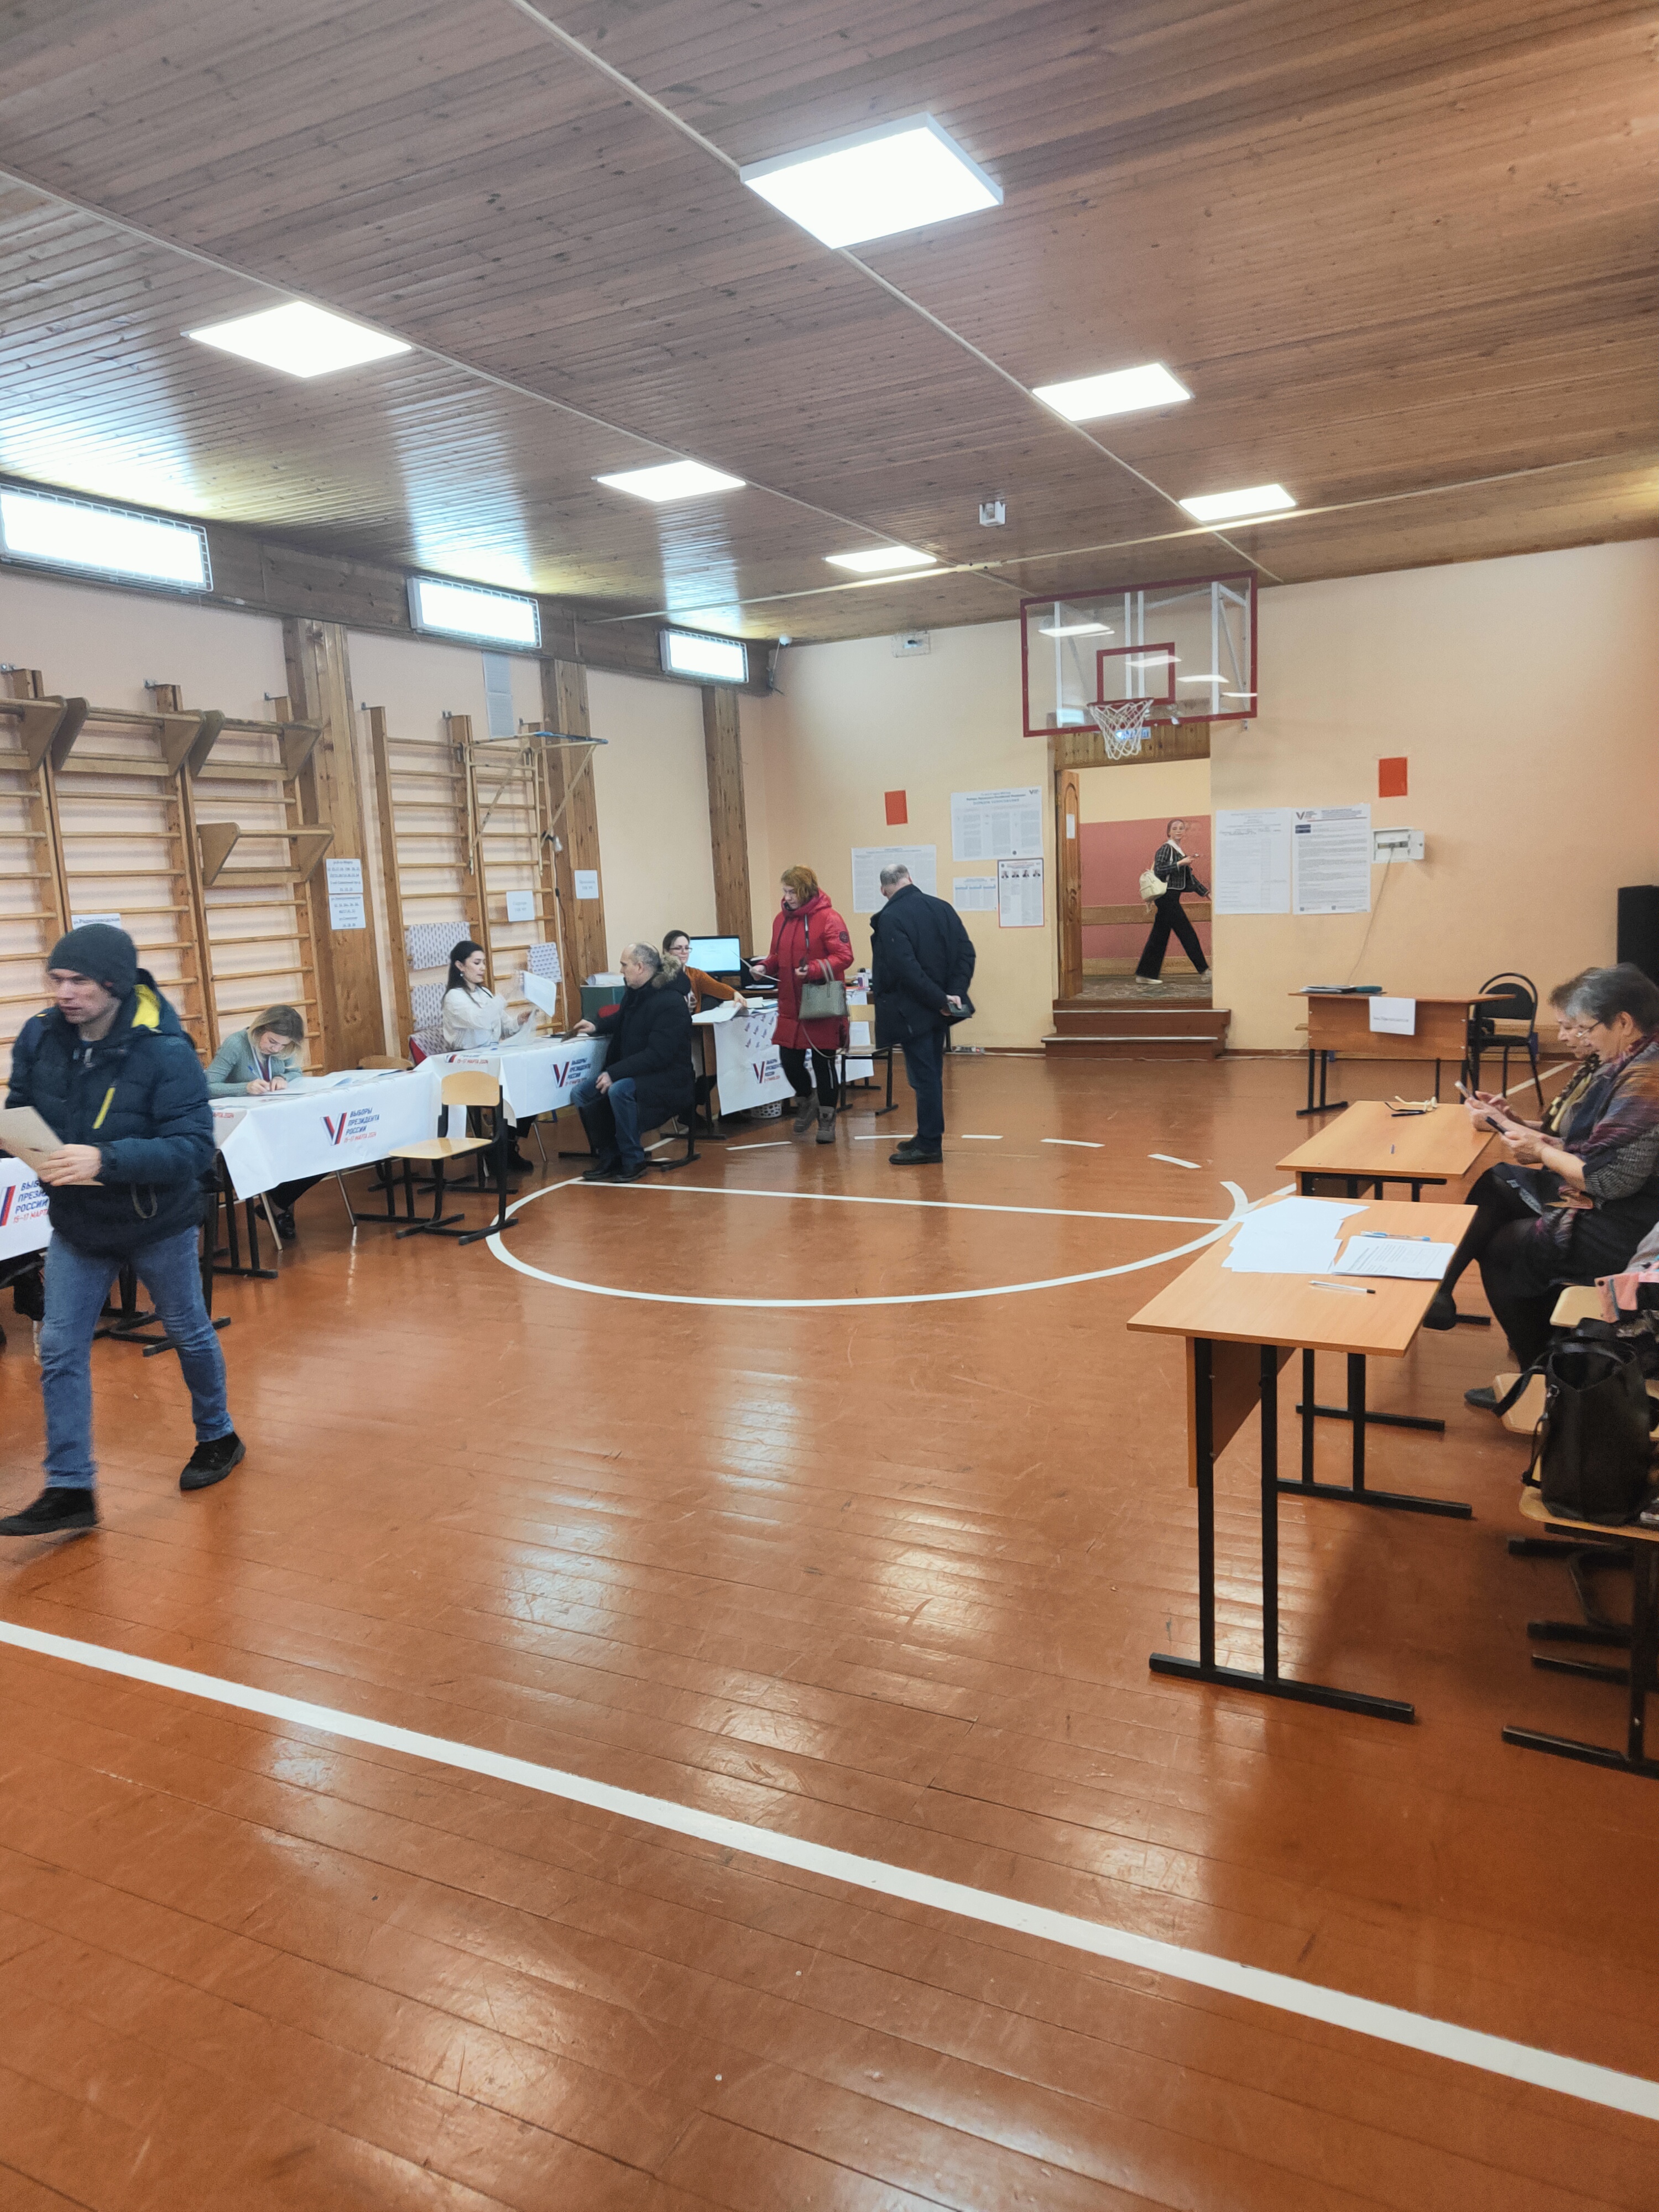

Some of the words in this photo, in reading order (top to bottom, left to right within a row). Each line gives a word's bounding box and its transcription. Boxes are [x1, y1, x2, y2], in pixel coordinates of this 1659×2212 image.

[349, 1107, 373, 1118] ВЫБОРЫ
[347, 1114, 380, 1127] ПРЕЗИДЕНТА
[346, 1125, 367, 1135] РОССИИ
[21, 1180, 40, 1191] ВЫБ
[15, 1198, 49, 1214] РОССИИ
[30, 1209, 49, 1218] МАРТ
